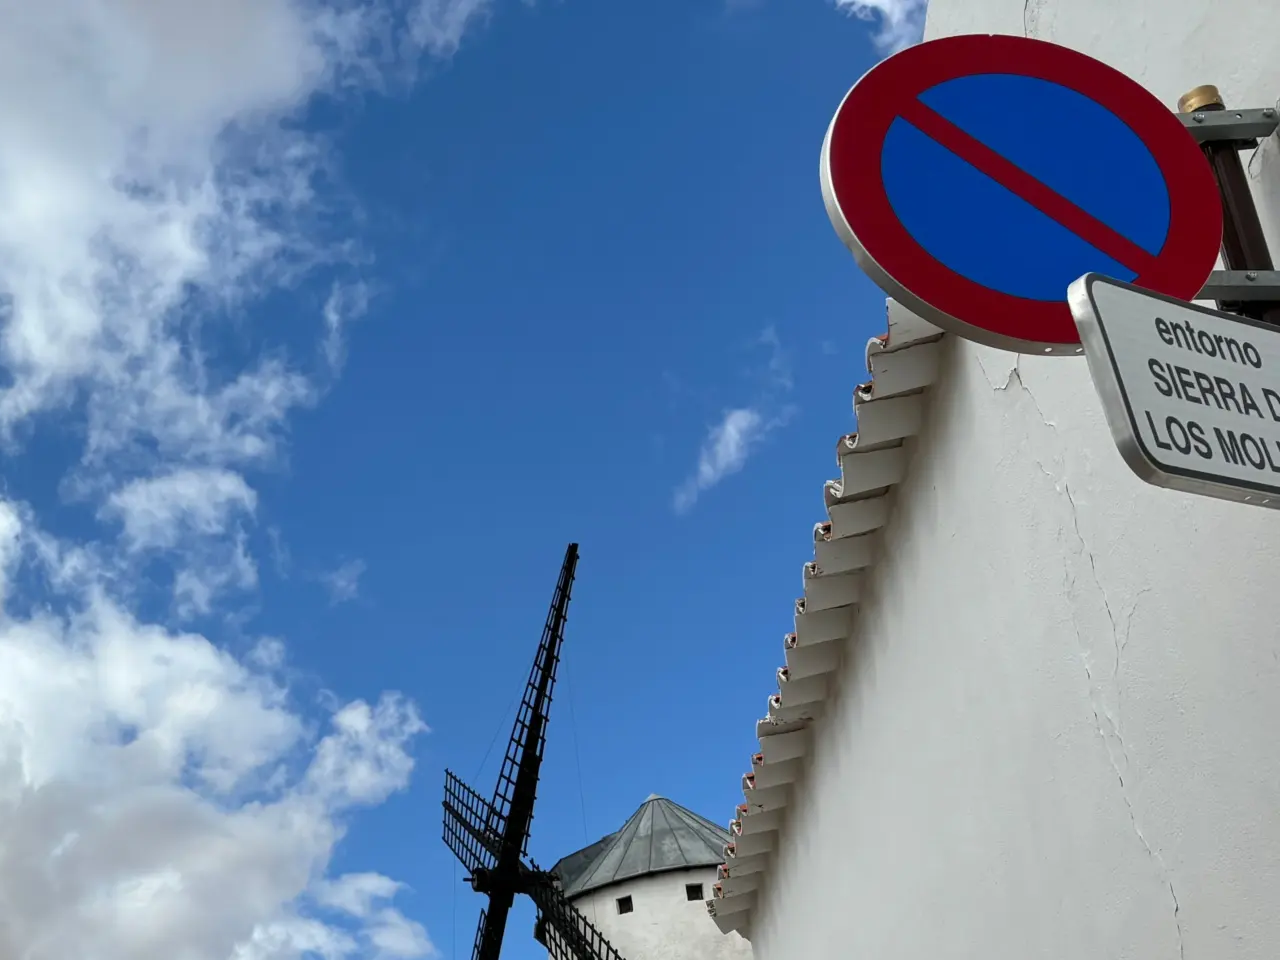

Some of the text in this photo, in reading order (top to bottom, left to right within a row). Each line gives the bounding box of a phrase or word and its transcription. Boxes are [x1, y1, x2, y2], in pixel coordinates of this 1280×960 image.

[1154, 317, 1262, 369] entorno
[1148, 358, 1265, 419] SIERRA
[1145, 410, 1280, 473] LOS MOL
